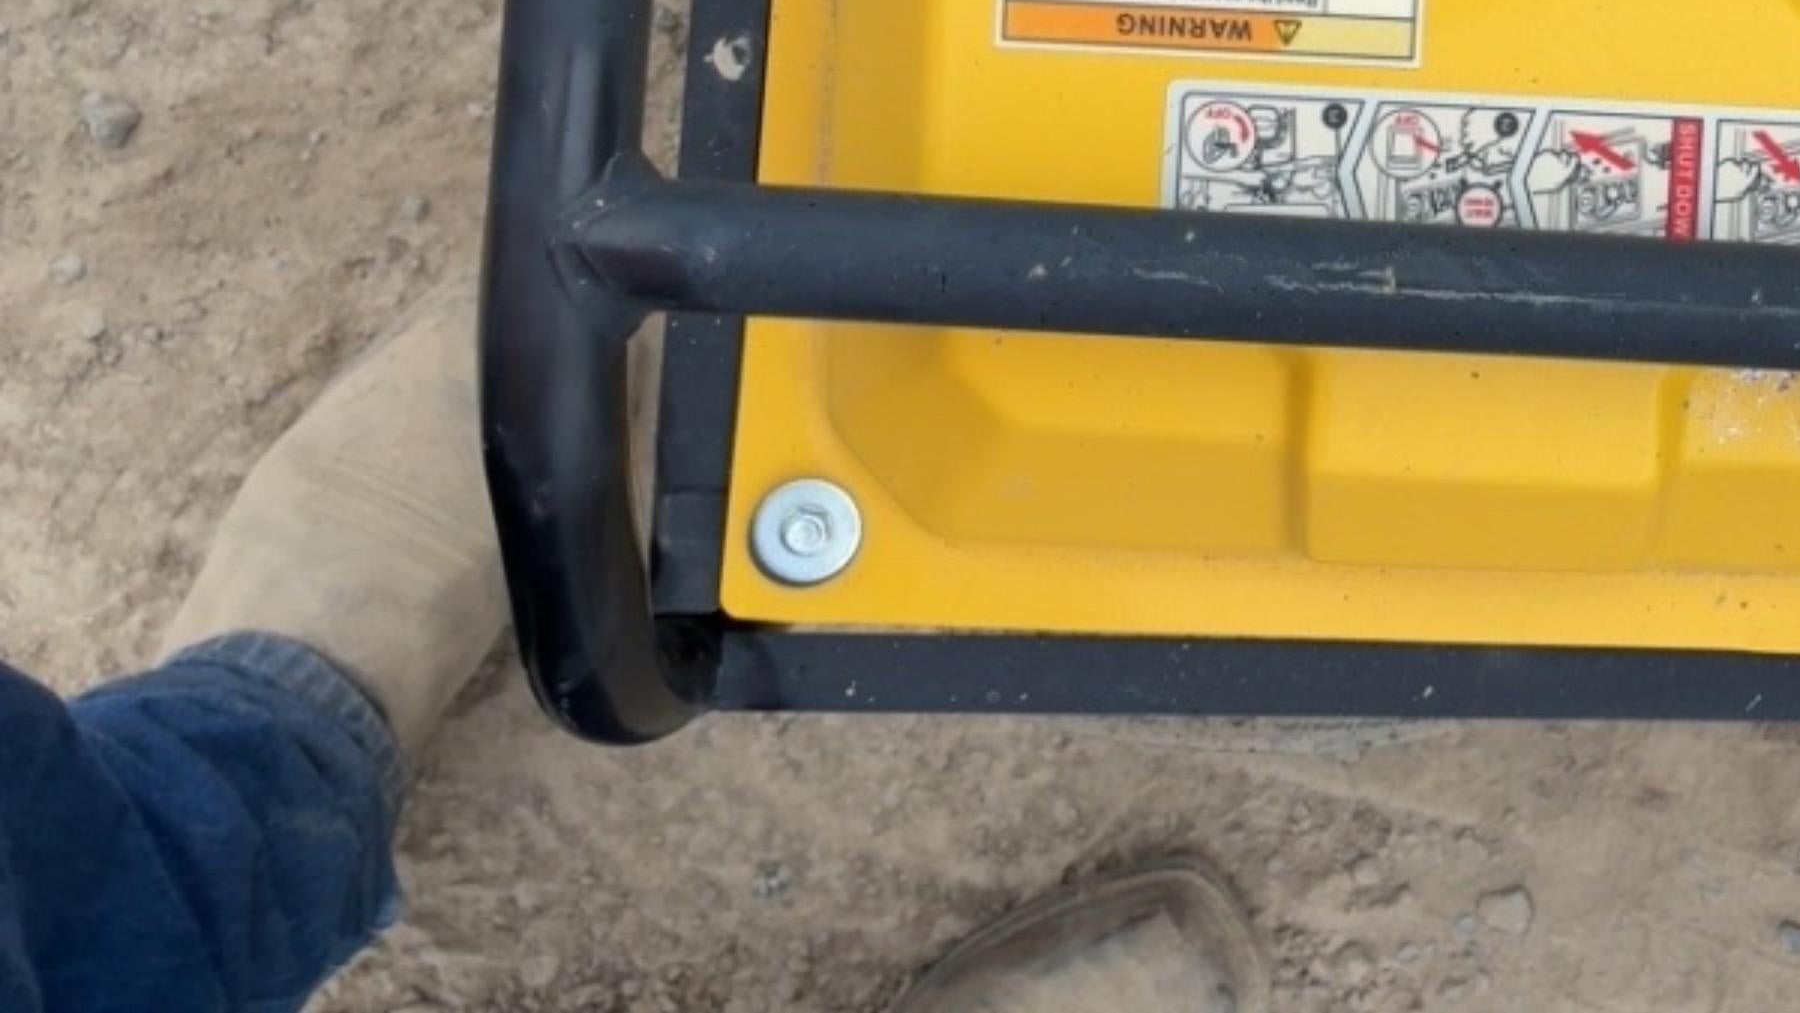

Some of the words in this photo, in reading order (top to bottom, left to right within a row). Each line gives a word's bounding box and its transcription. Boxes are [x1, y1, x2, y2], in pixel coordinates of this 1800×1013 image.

[1116, 14, 1252, 41] WARNING
[1675, 124, 1697, 176] SHUT
[1670, 185, 1692, 238] DOW
